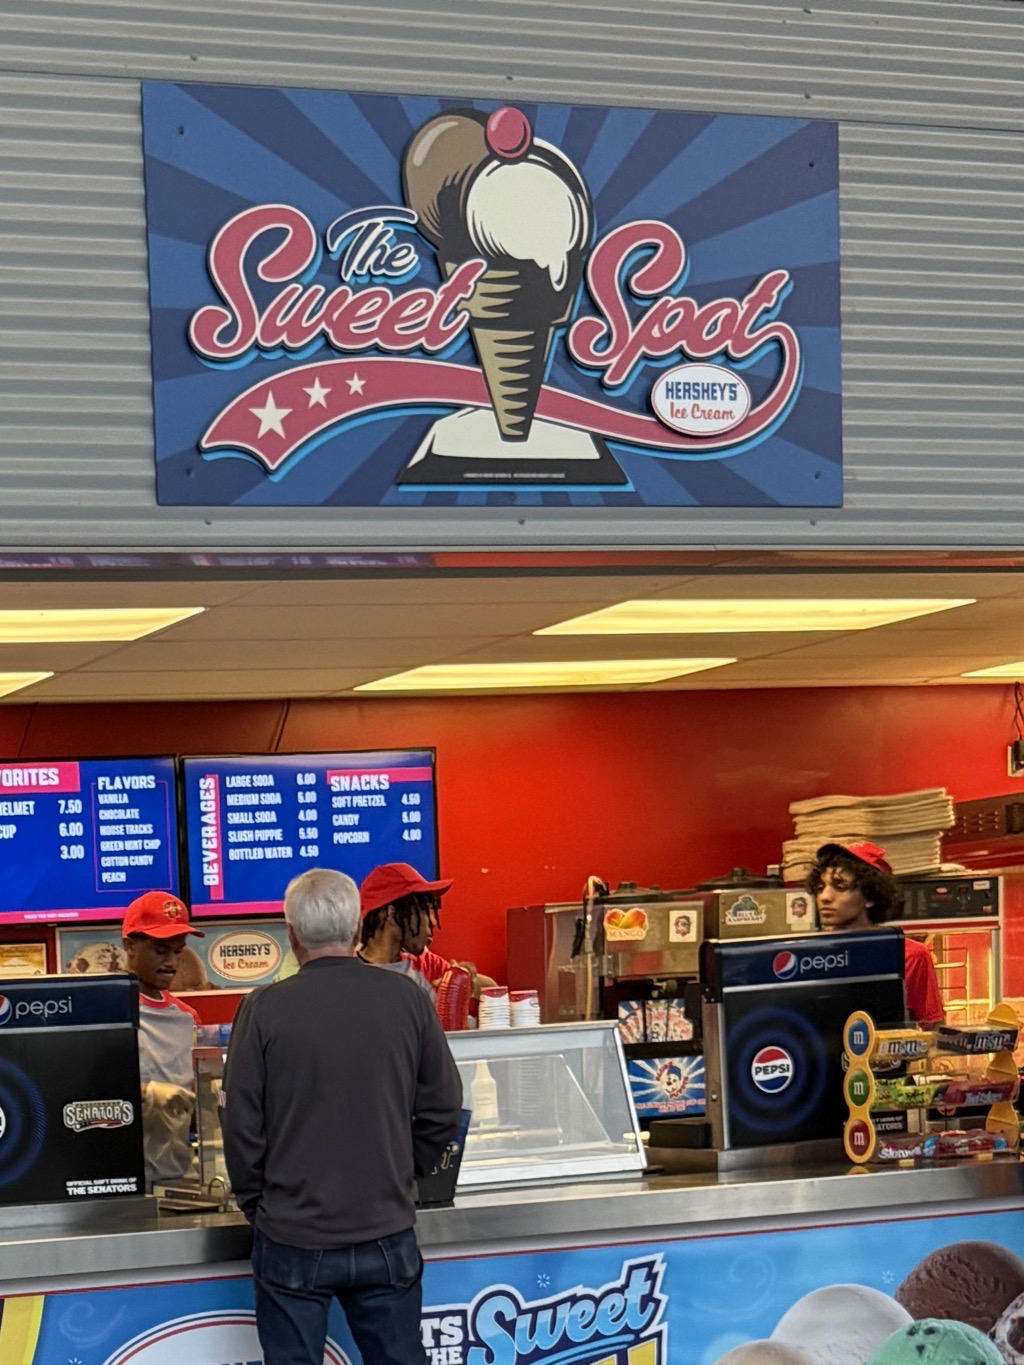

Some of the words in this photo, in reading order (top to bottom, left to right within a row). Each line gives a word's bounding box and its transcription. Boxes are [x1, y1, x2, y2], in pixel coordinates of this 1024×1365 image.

[327, 205, 418, 282] The
[189, 203, 487, 358] Sweet
[569, 219, 792, 386] Spot
[664, 381, 739, 401] HERSHEY'S
[670, 402, 689, 419] Ice
[691, 403, 735, 420] Cream
[97, 774, 156, 790] FLAVORS
[225, 776, 252, 787] LARGE
[252, 774, 275, 786] SODA
[330, 774, 390, 792] SNACKS
[98, 793, 129, 804] VANILLA
[226, 794, 259, 806] MEDIUM
[260, 792, 282, 805] SODA
[331, 796, 352, 808] SOFT
[352, 794, 387, 808] PRETZEL
[58, 799, 83, 814] 7.50
[98, 808, 140, 820] CHOCOLATE
[227, 812, 255, 824] SMALL
[255, 811, 277, 823] SODA
[332, 814, 360, 826] CANDY
[59, 822, 83, 837] 6.00
[99, 825, 125, 836] MOOSE
[125, 824, 153, 835] TRACKS
[199, 777, 219, 886] BEVERAGES
[228, 830, 254, 843] SLUSH
[254, 828, 283, 841] PUPPIE
[333, 831, 370, 844] POPCORN
[60, 845, 84, 860] 3.00
[228, 847, 264, 861] BOTTLED
[264, 846, 293, 859] WATER
[101, 856, 129, 867] COTTON
[129, 855, 154, 866] CANDY
[101, 871, 126, 883] PEACH
[608, 929, 643, 938] MANGO
[219, 943, 271, 957] HERSHEY'S
[223, 958, 235, 969] Ice
[238, 958, 268, 969] Cream
[800, 950, 849, 974] pepsi
[15, 996, 72, 1019] pepsi
[853, 1031, 864, 1045] m
[755, 1063, 790, 1075] PEPSI
[854, 1081, 864, 1095] m
[66, 1104, 132, 1125] SENATORS
[854, 1132, 864, 1146] m
[66, 1186, 87, 1196] THE
[87, 1184, 137, 1194] SENATORS
[421, 1315, 463, 1347] TS
